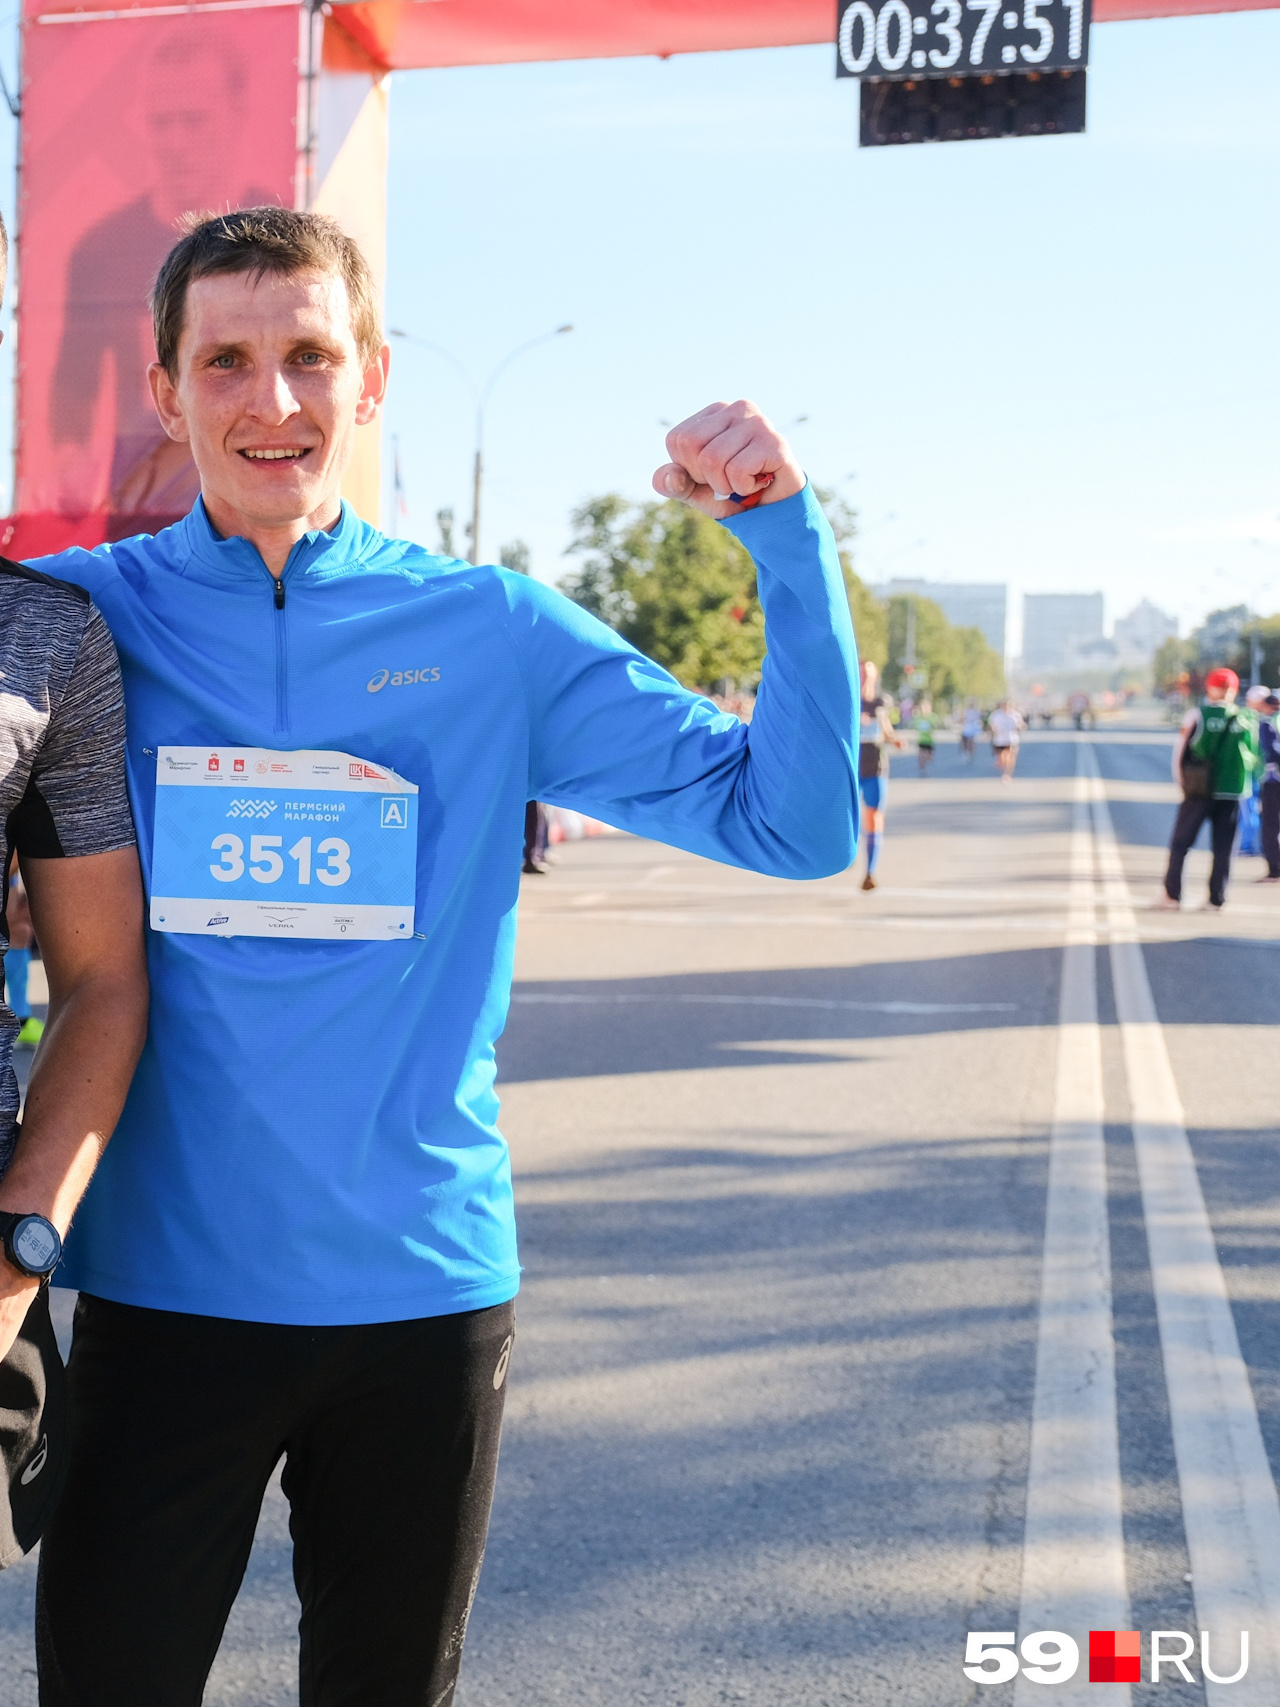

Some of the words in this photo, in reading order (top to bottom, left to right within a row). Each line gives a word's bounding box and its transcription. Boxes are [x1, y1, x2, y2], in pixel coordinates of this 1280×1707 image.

[839, 0, 1082, 73] 00:37:51
[284, 801, 346, 812] ПЕРМСКИЙ
[284, 812, 339, 822] МАРАФОН
[210, 833, 351, 886] 3513
